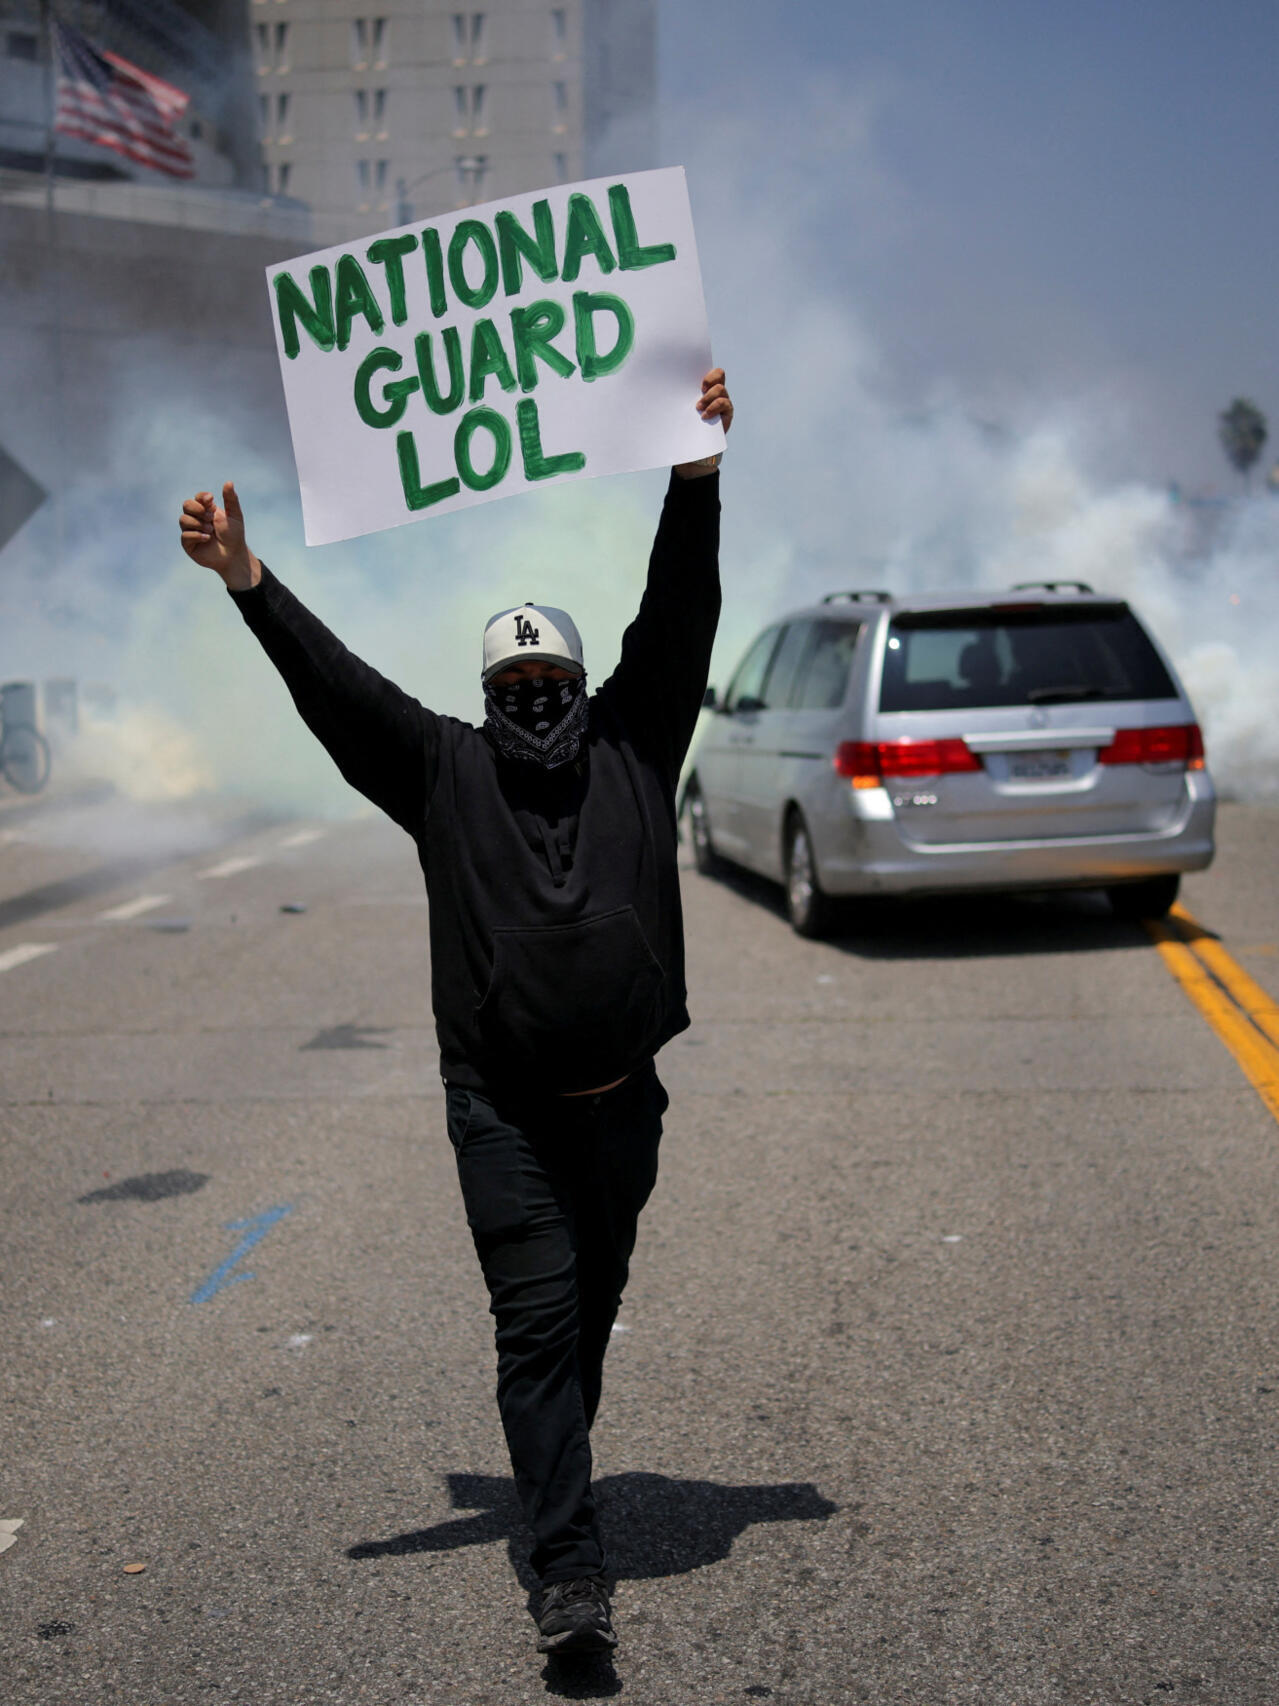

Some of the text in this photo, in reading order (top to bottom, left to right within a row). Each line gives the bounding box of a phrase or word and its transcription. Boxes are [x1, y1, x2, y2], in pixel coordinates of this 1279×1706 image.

[273, 184, 676, 359] NATIONAL
[354, 291, 635, 429] GUARD
[396, 398, 587, 511] LOL
[514, 615, 539, 646] LA
